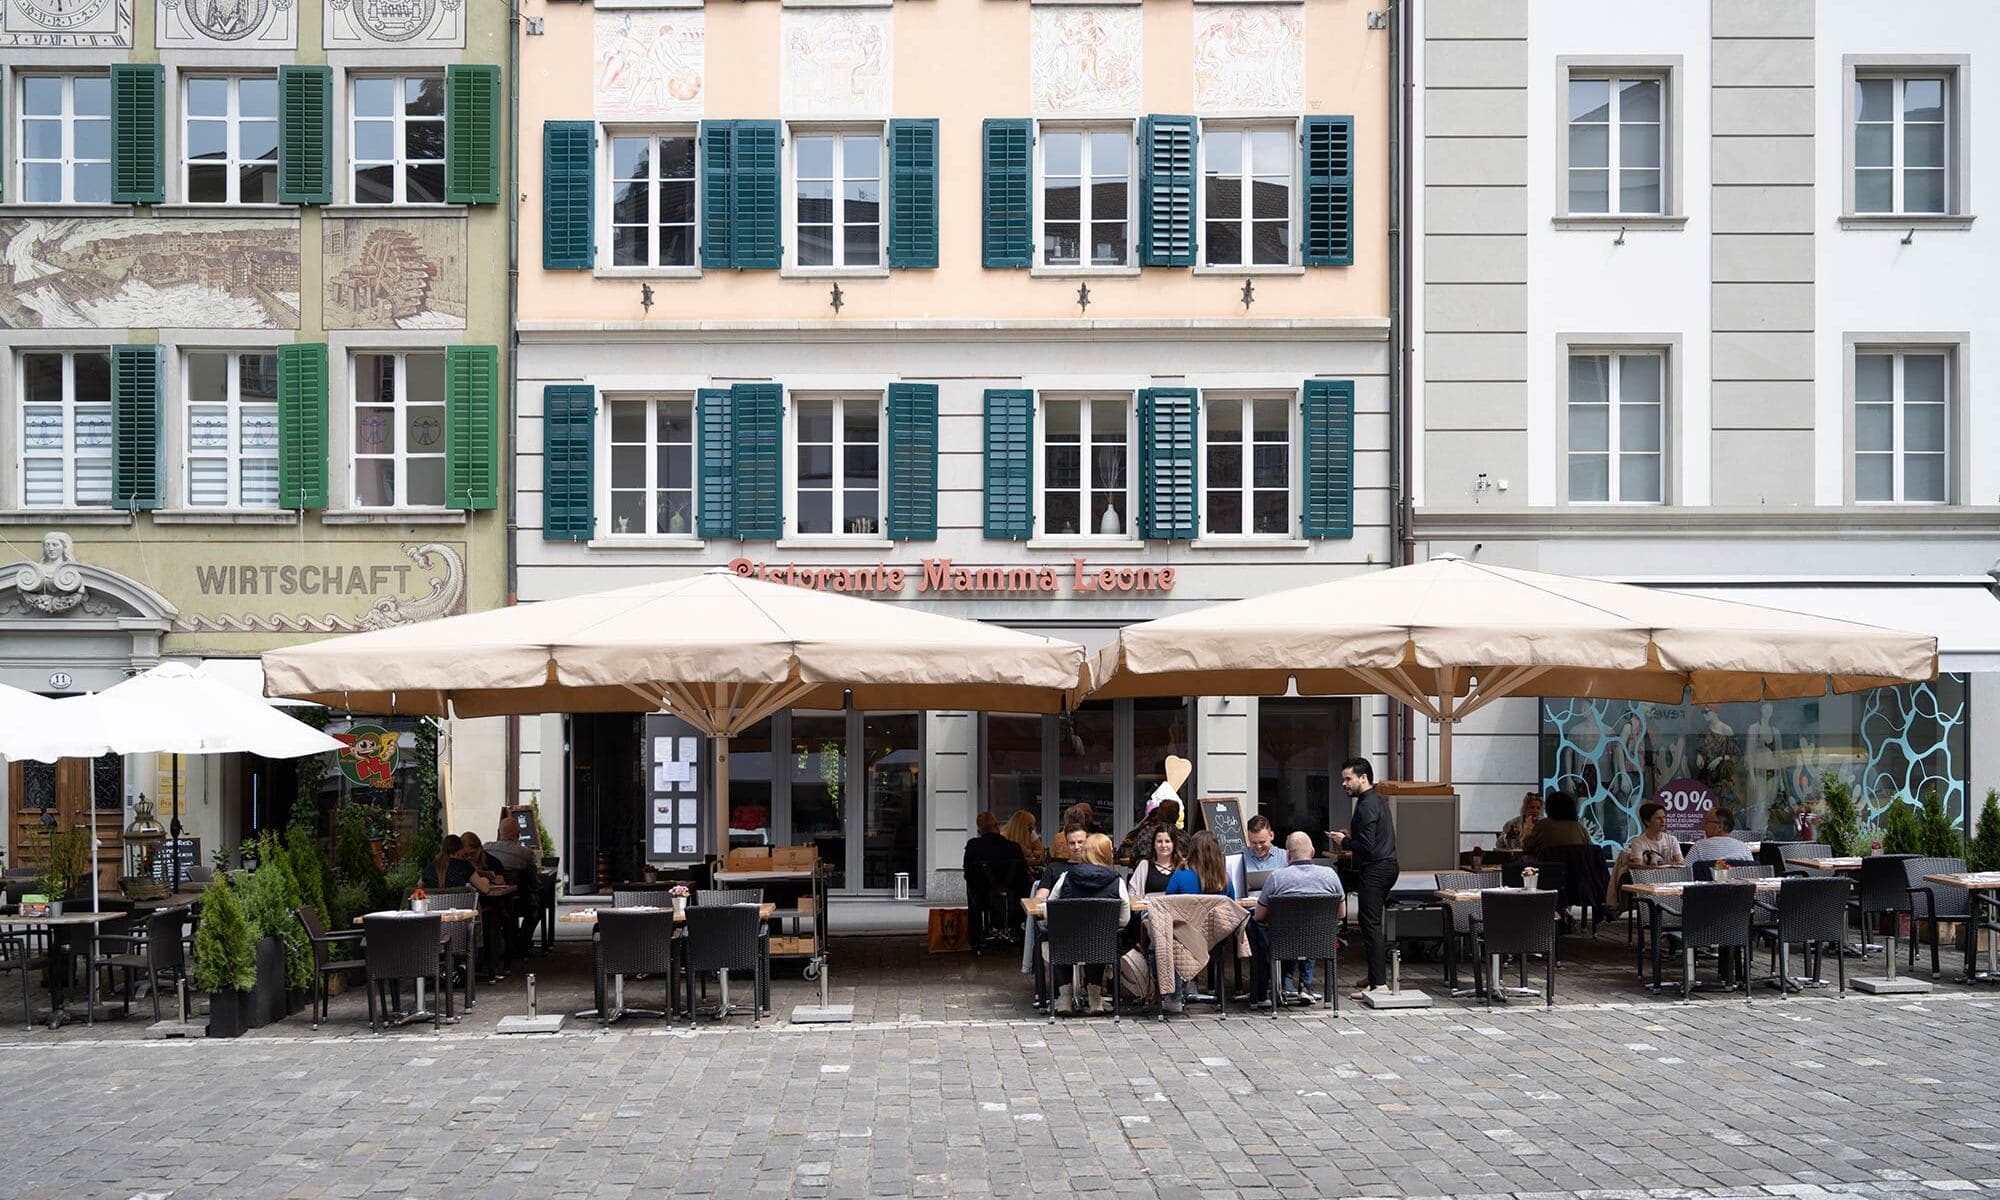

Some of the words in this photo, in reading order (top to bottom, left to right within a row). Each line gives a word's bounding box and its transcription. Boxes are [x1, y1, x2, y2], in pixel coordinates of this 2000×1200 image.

[10, 34, 20, 45] X
[33, 34, 41, 45] XI
[50, 34, 60, 45] XII
[196, 565, 411, 594] WIRTSCHAFT
[917, 558, 1059, 592] Mamma
[1072, 557, 1176, 592] Leone
[56, 675, 65, 683] 11
[1660, 791, 1713, 812] 30%
